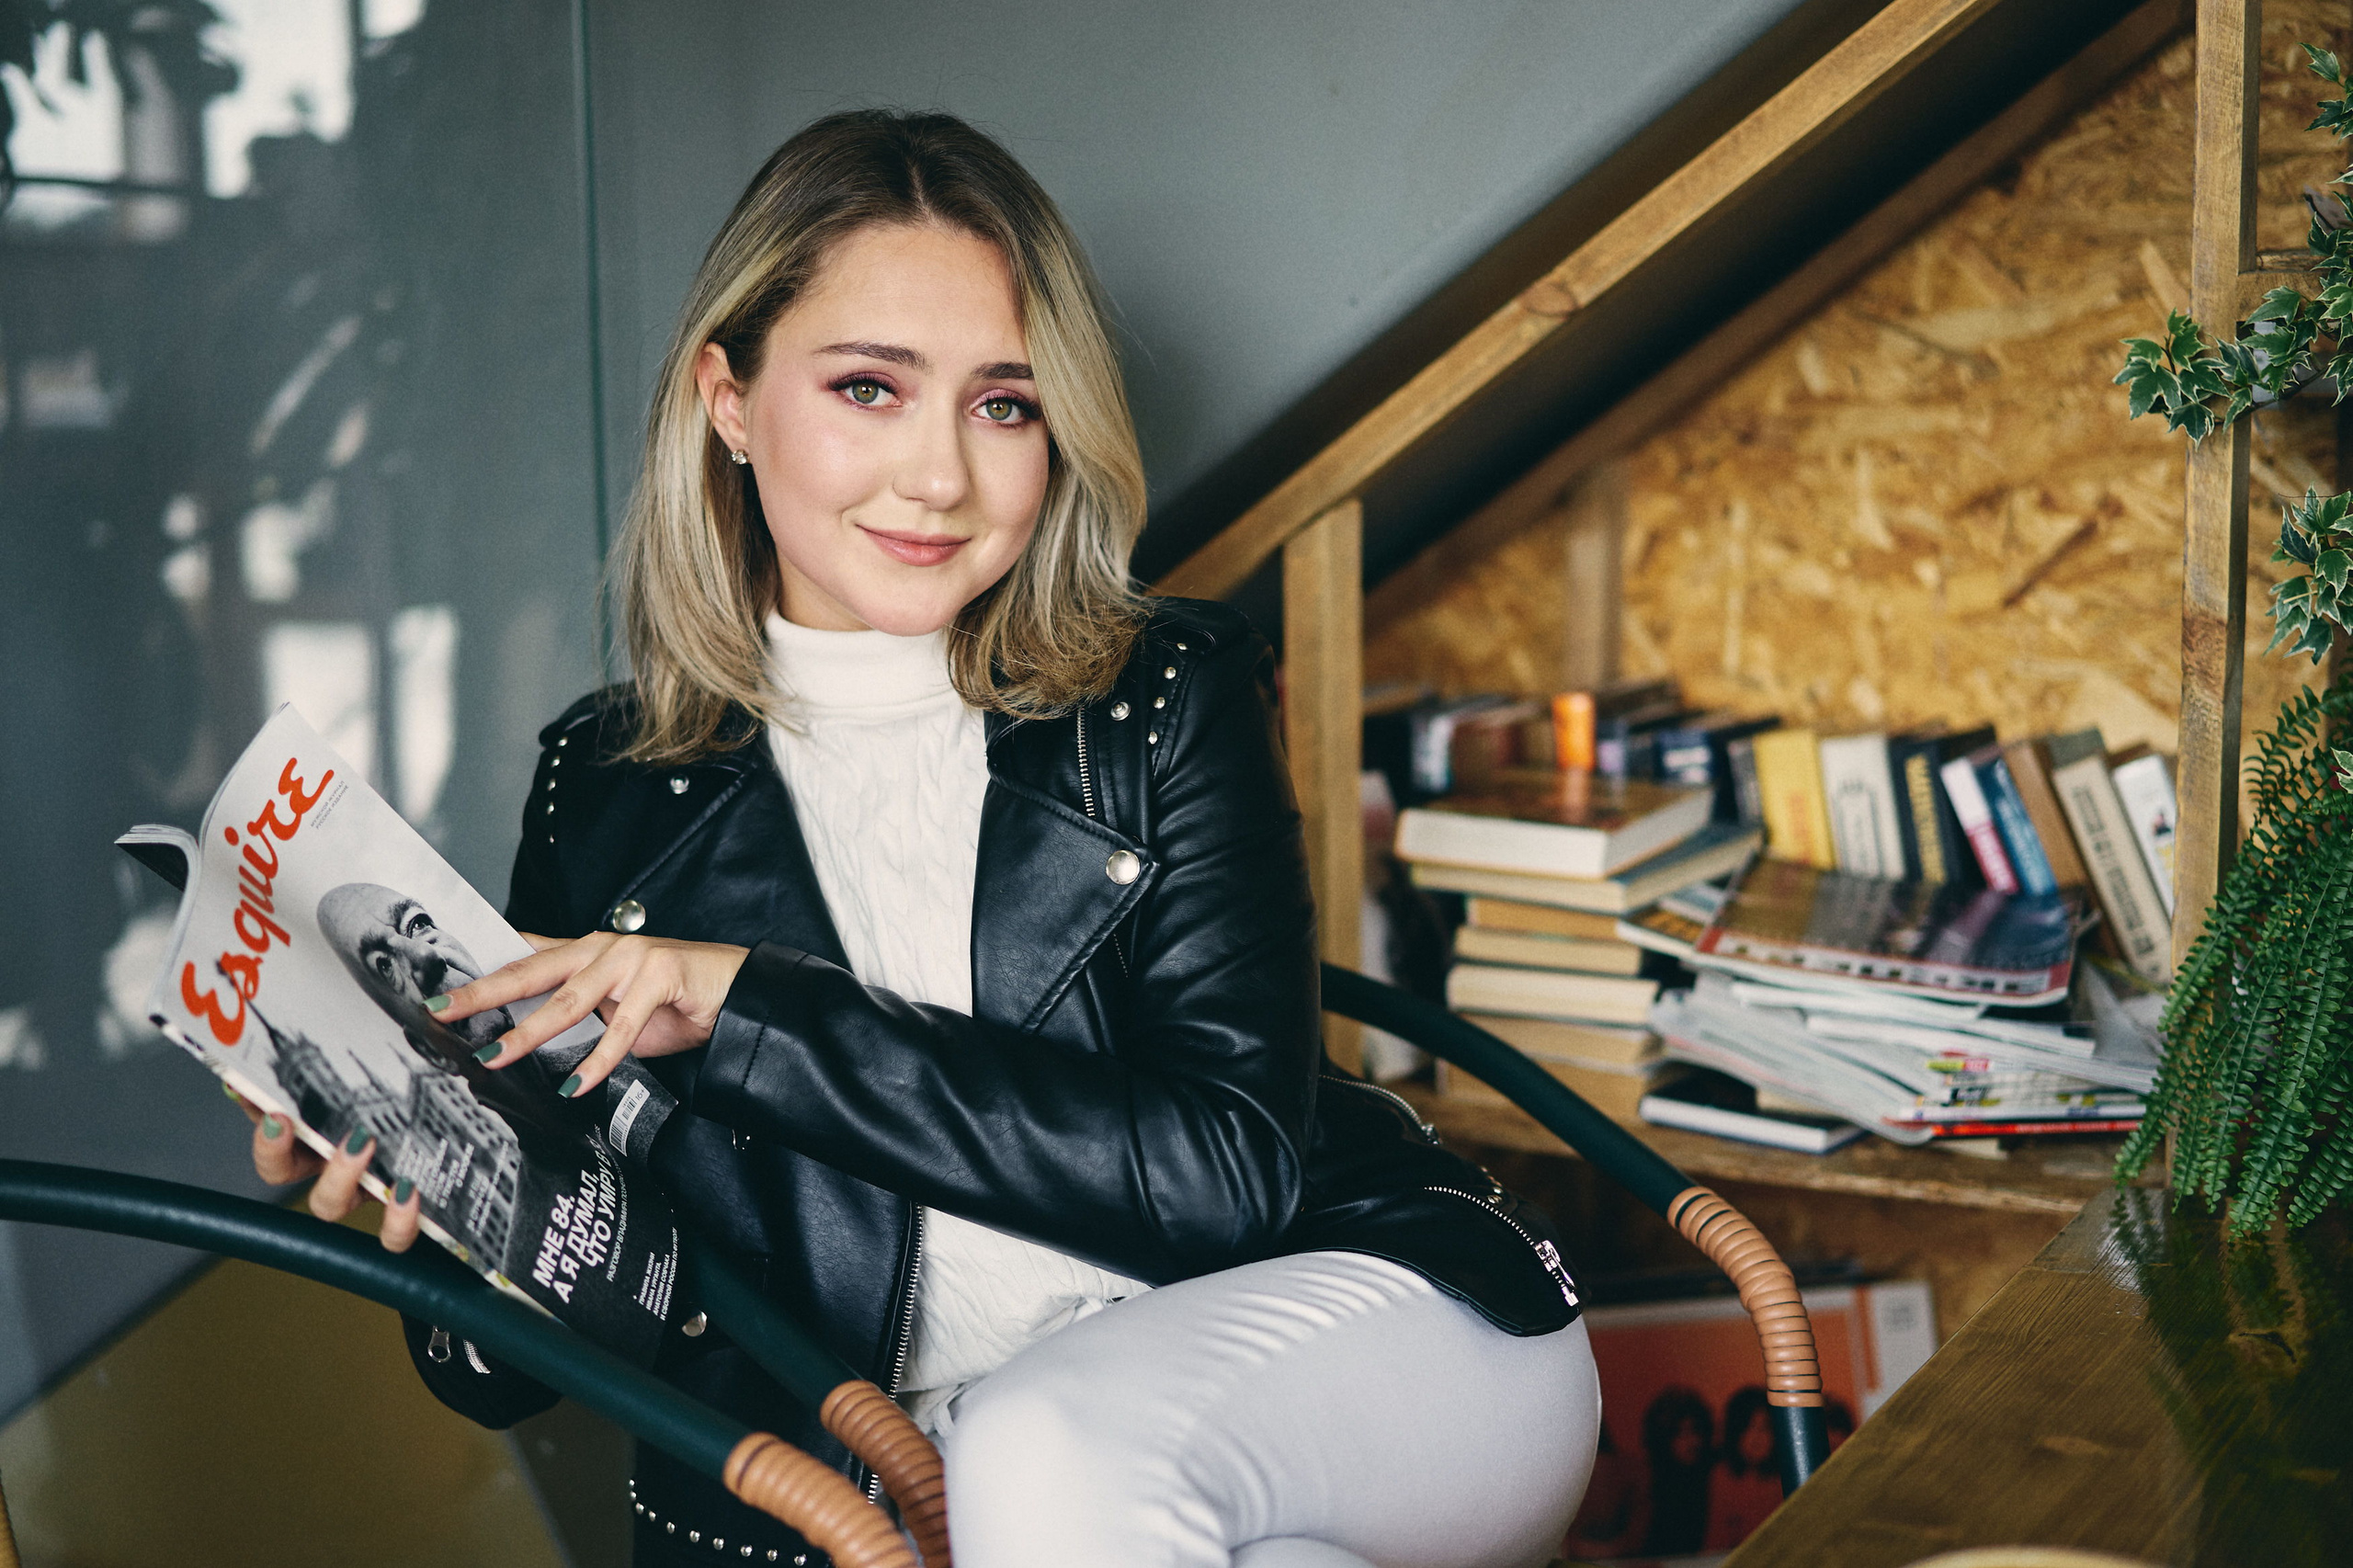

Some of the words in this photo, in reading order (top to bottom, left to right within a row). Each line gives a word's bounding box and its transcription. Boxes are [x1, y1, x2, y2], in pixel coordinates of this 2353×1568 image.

[311, 801, 329, 827] МУЖСКОЙ
[329, 780, 345, 801] ЖУРНАЛ
[315, 807, 332, 830] РУССКОЕ
[332, 785, 348, 808] ИЗДАНИЕ
[181, 757, 334, 1046] Esquire
[635, 1088, 645, 1101] 16+
[595, 1150, 611, 1167] В
[597, 1161, 616, 1221] УМРУ
[566, 1169, 599, 1260] ДУМАЛ,
[532, 1225, 565, 1289] МНЕ
[551, 1193, 576, 1230] 84.
[584, 1219, 611, 1267] ЧТО
[607, 1241, 622, 1282] РАЗГОВОР
[617, 1199, 628, 1244] ВЛАДИМИРА
[672, 1251, 678, 1261] ПО
[560, 1253, 580, 1280] Я
[638, 1275, 651, 1305] ПРАВИЛА
[646, 1251, 655, 1277] ЖИЗНИ
[653, 1281, 665, 1316] АНАТОЛИЯ
[661, 1254, 670, 1283] СОБЧАКА
[668, 1259, 677, 1286] РОССИИ
[552, 1279, 574, 1304] А
[645, 1288, 656, 1311] ИВАНА
[662, 1283, 673, 1315] СБОРНОЙ
